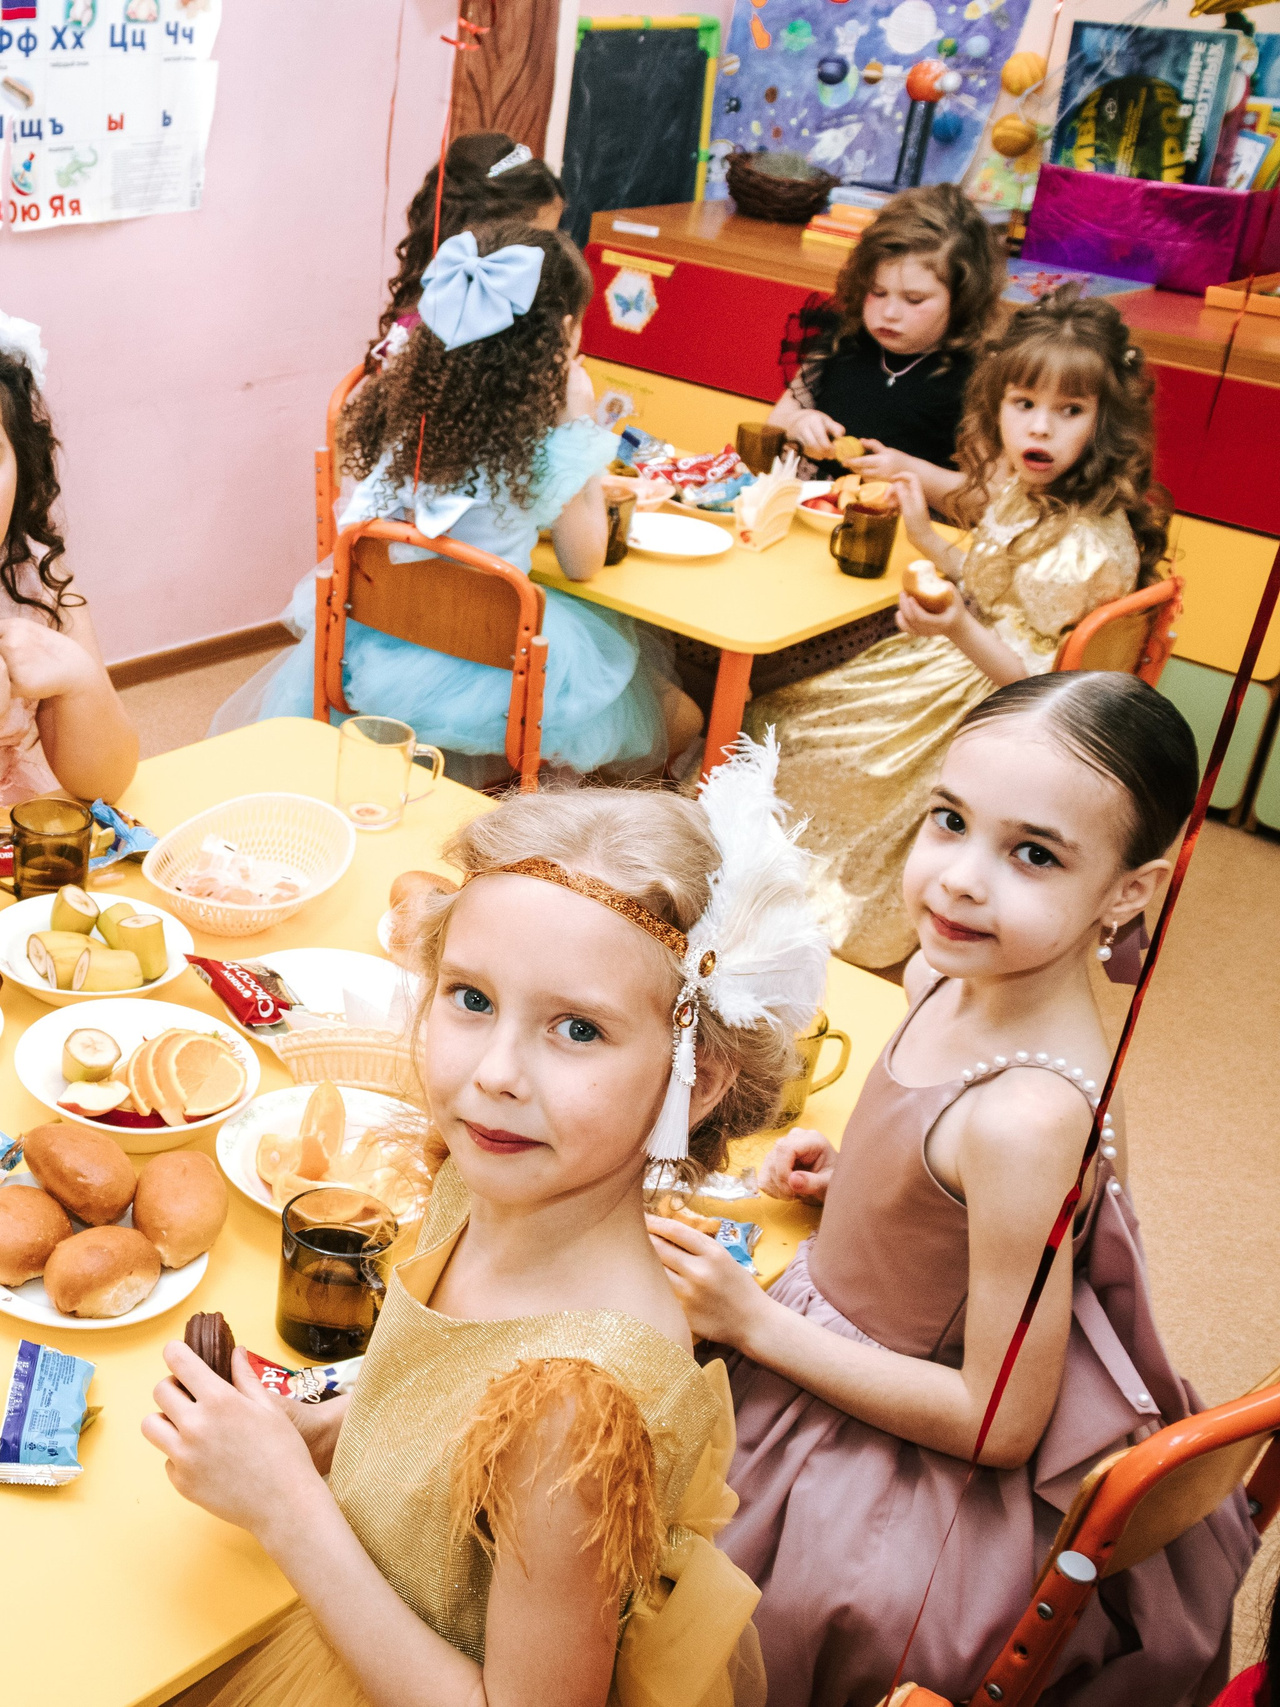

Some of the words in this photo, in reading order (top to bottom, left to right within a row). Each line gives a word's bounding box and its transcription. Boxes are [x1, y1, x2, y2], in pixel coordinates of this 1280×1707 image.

[1183, 40, 1207, 101] МИРЕ
[1176, 103, 1195, 119] В
[1184, 41, 1226, 163] ЖИВОТНЫХ
